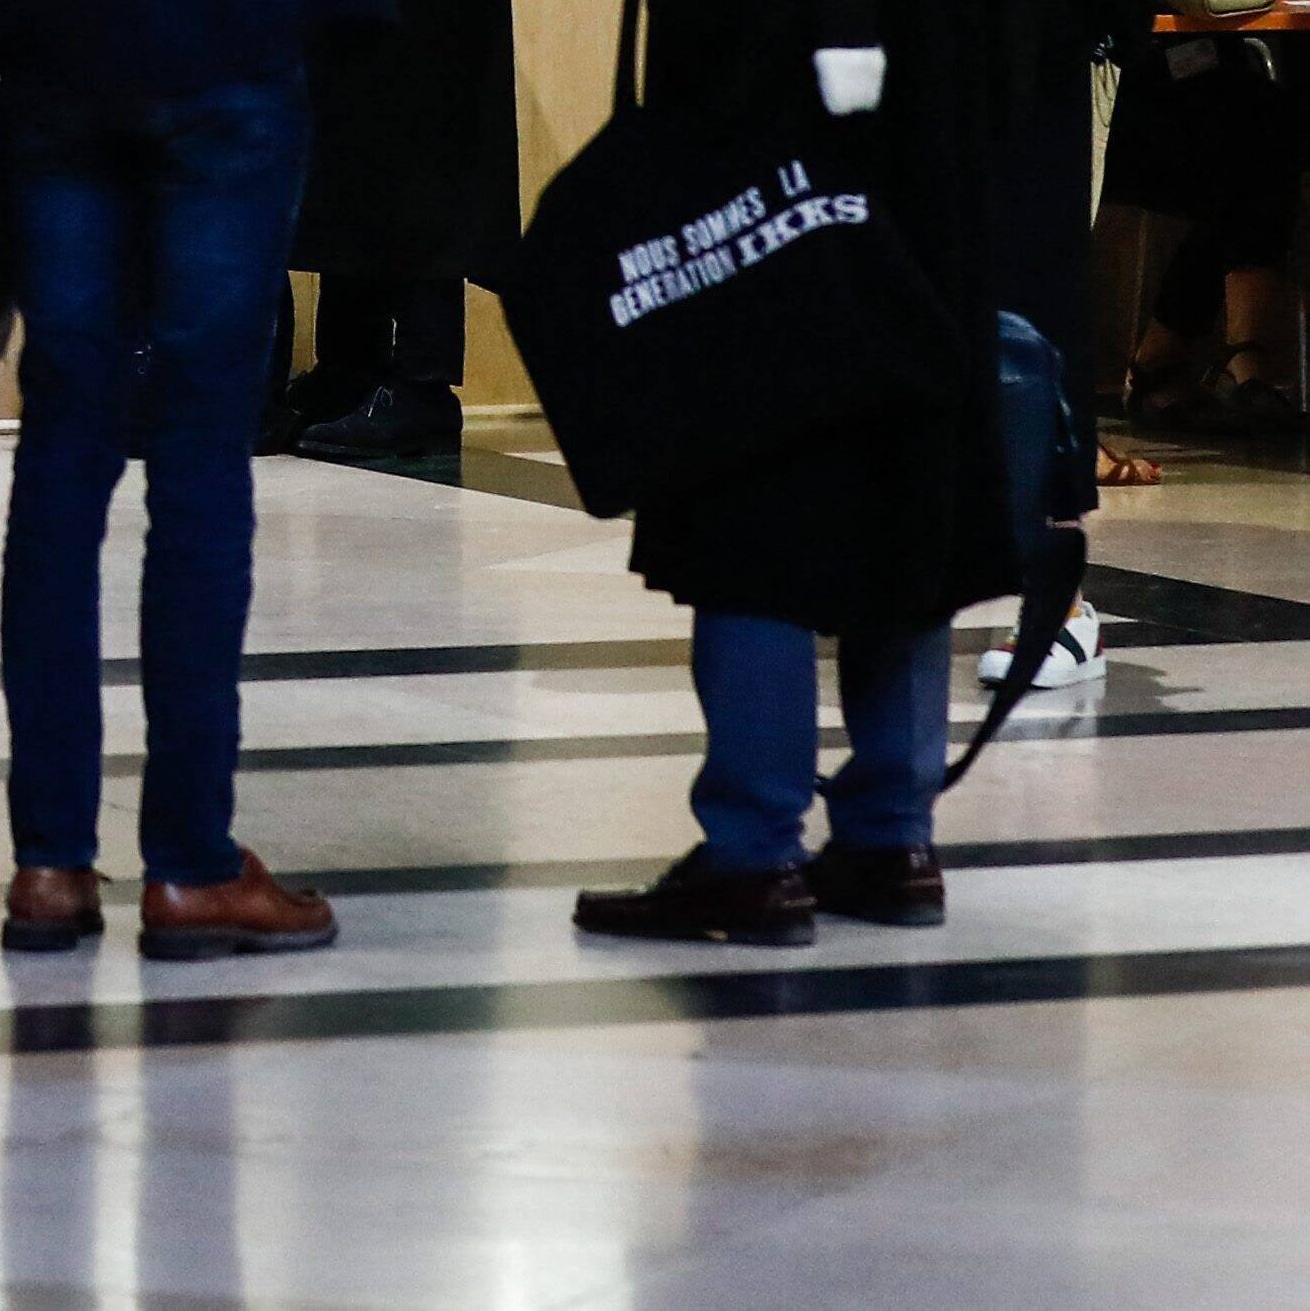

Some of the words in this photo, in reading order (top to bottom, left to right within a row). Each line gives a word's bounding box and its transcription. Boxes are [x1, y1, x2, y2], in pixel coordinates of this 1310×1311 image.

[617, 235, 679, 284] NOUS
[681, 186, 767, 257] SOMMES
[778, 159, 811, 198] LA
